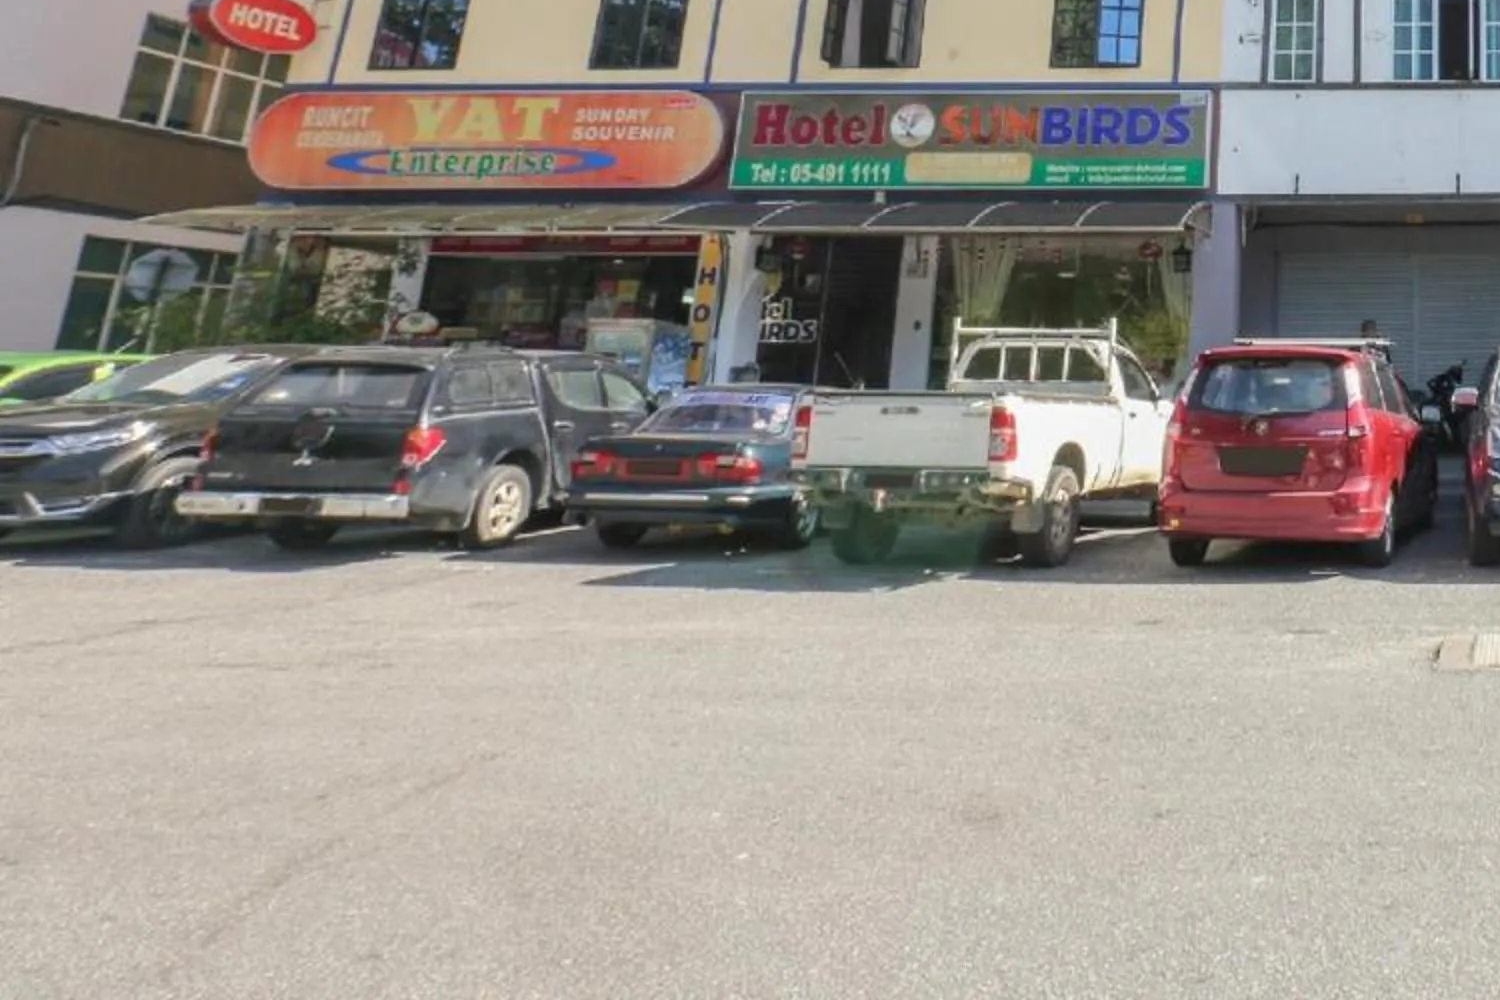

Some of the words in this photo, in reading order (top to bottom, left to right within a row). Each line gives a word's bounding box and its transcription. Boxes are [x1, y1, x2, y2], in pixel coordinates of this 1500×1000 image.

[228, 3, 302, 41] HOTEL
[408, 96, 561, 142] YAT
[575, 107, 652, 124] SUNDRY
[751, 104, 885, 146] Hotel
[571, 125, 676, 142] SOUVENIR
[389, 149, 556, 179] Enterprise
[852, 162, 891, 183] 1111
